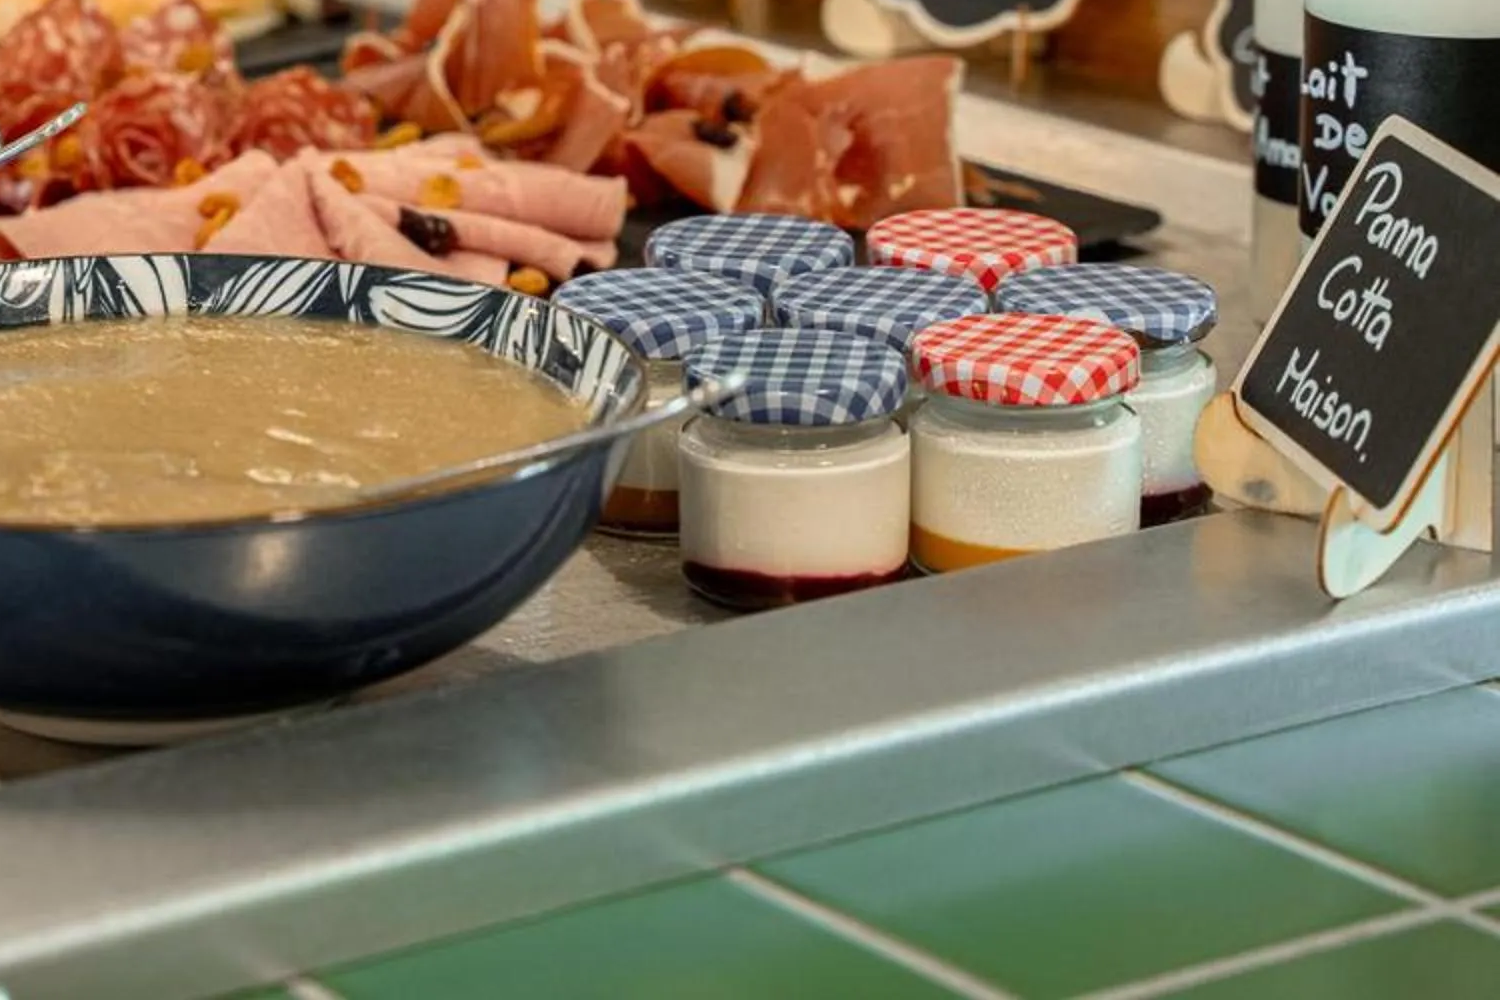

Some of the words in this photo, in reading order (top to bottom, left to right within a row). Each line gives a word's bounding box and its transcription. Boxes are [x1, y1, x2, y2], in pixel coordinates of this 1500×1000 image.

[1300, 51, 1368, 109] ait
[1313, 112, 1368, 160] De
[1355, 161, 1438, 280] Panna
[1317, 255, 1393, 351] Cotta
[1276, 346, 1373, 463] Maison.
